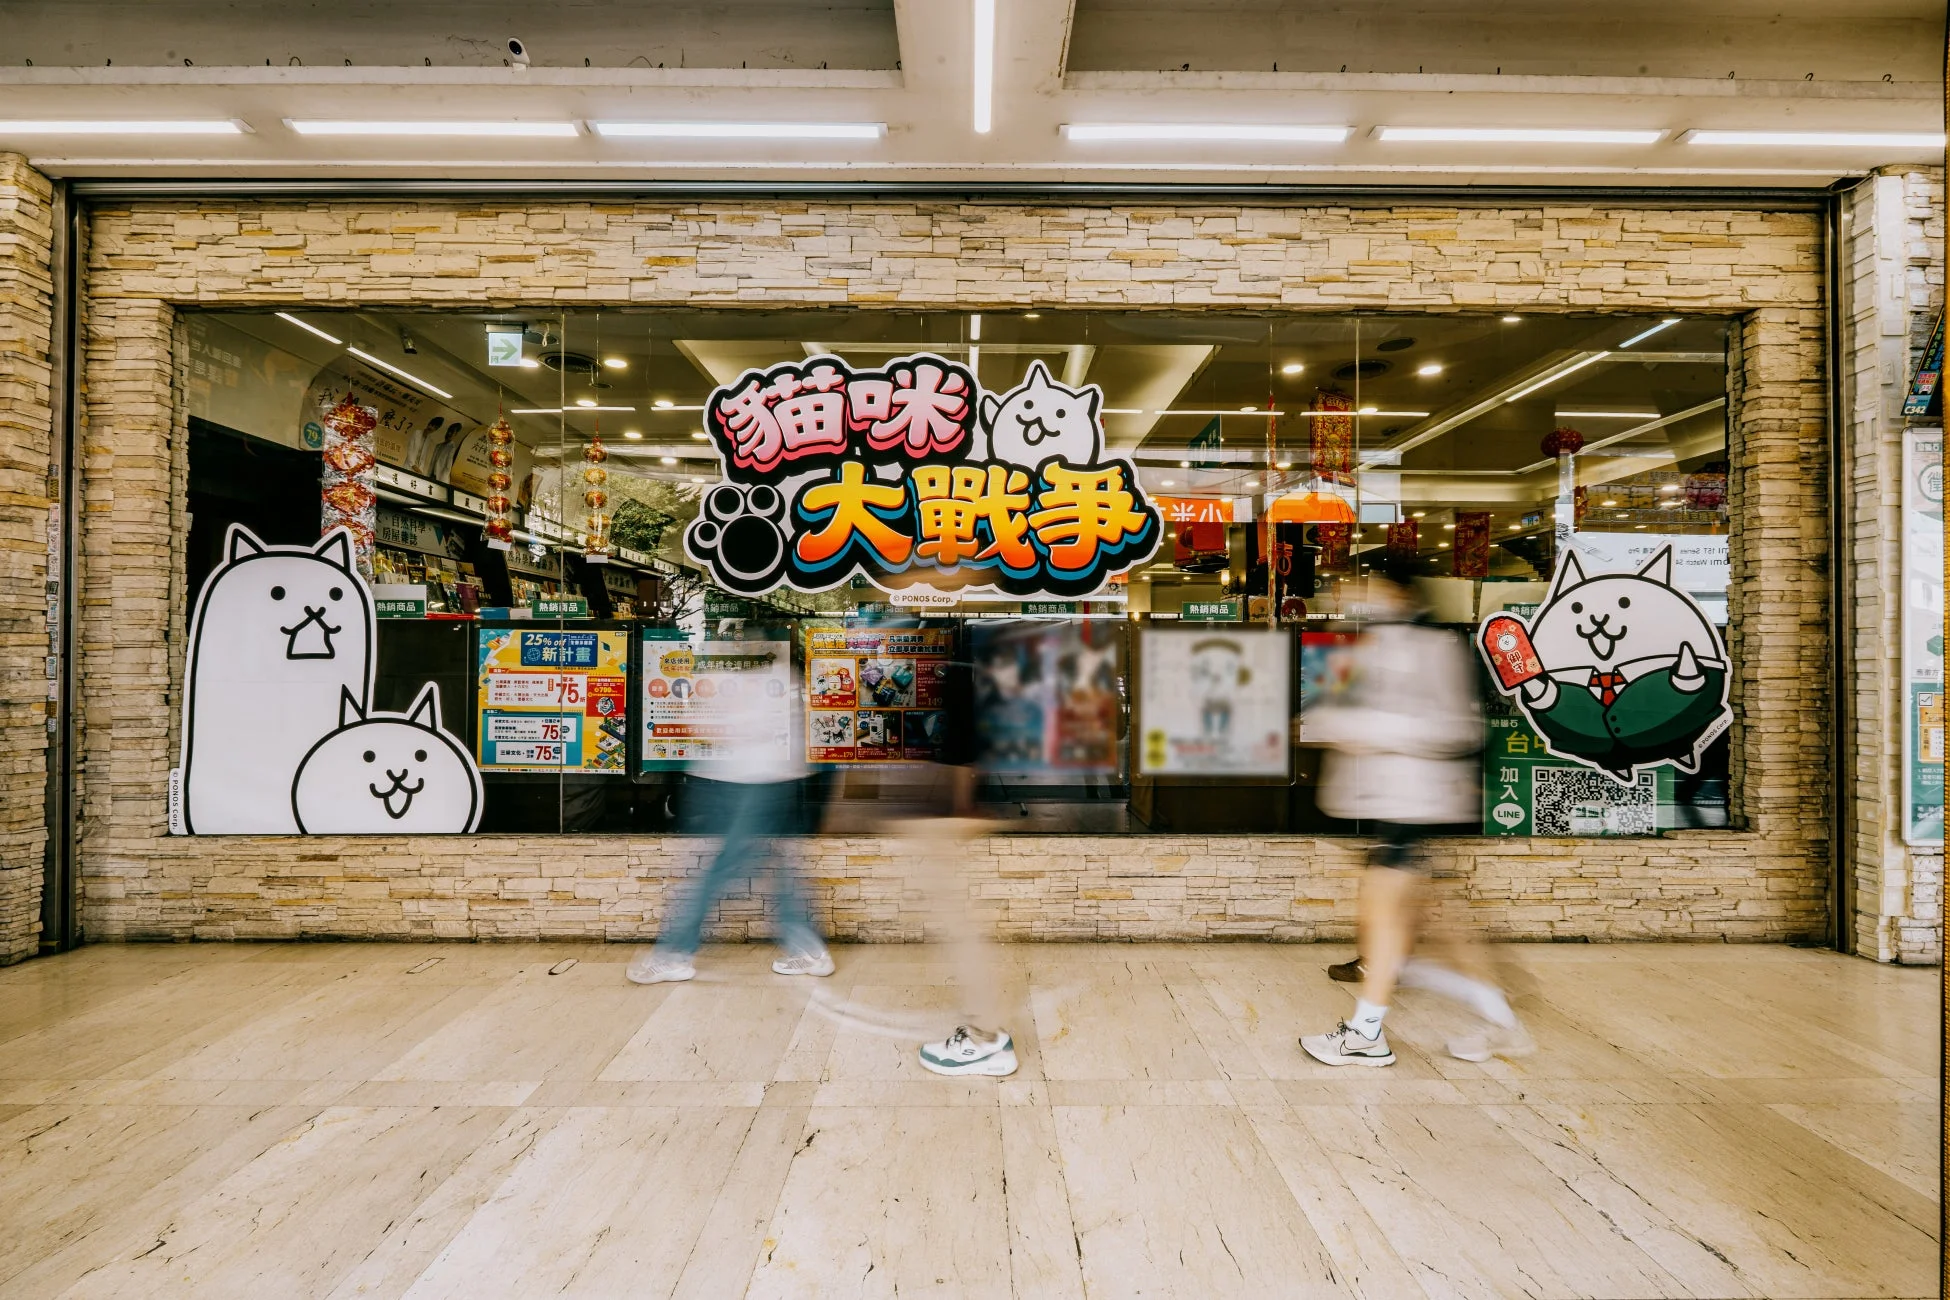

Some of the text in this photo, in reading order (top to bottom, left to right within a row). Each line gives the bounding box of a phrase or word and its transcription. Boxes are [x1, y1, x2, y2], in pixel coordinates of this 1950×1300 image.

[1904, 405, 1926, 414] C342
[715, 365, 970, 473] 貓咪
[793, 461, 1152, 578] 大戰爭
[901, 595, 931, 603] PONOS
[932, 595, 953, 604] Corp.
[524, 633, 552, 646] 25%
[541, 647, 592, 663] 新計畫
[1507, 651, 1524, 673] 御守
[541, 725, 559, 740] 75
[1702, 729, 1718, 744] PONOS
[1716, 719, 1729, 730] Corp.
[535, 745, 552, 760] 75
[1497, 810, 1521, 819] LINE
